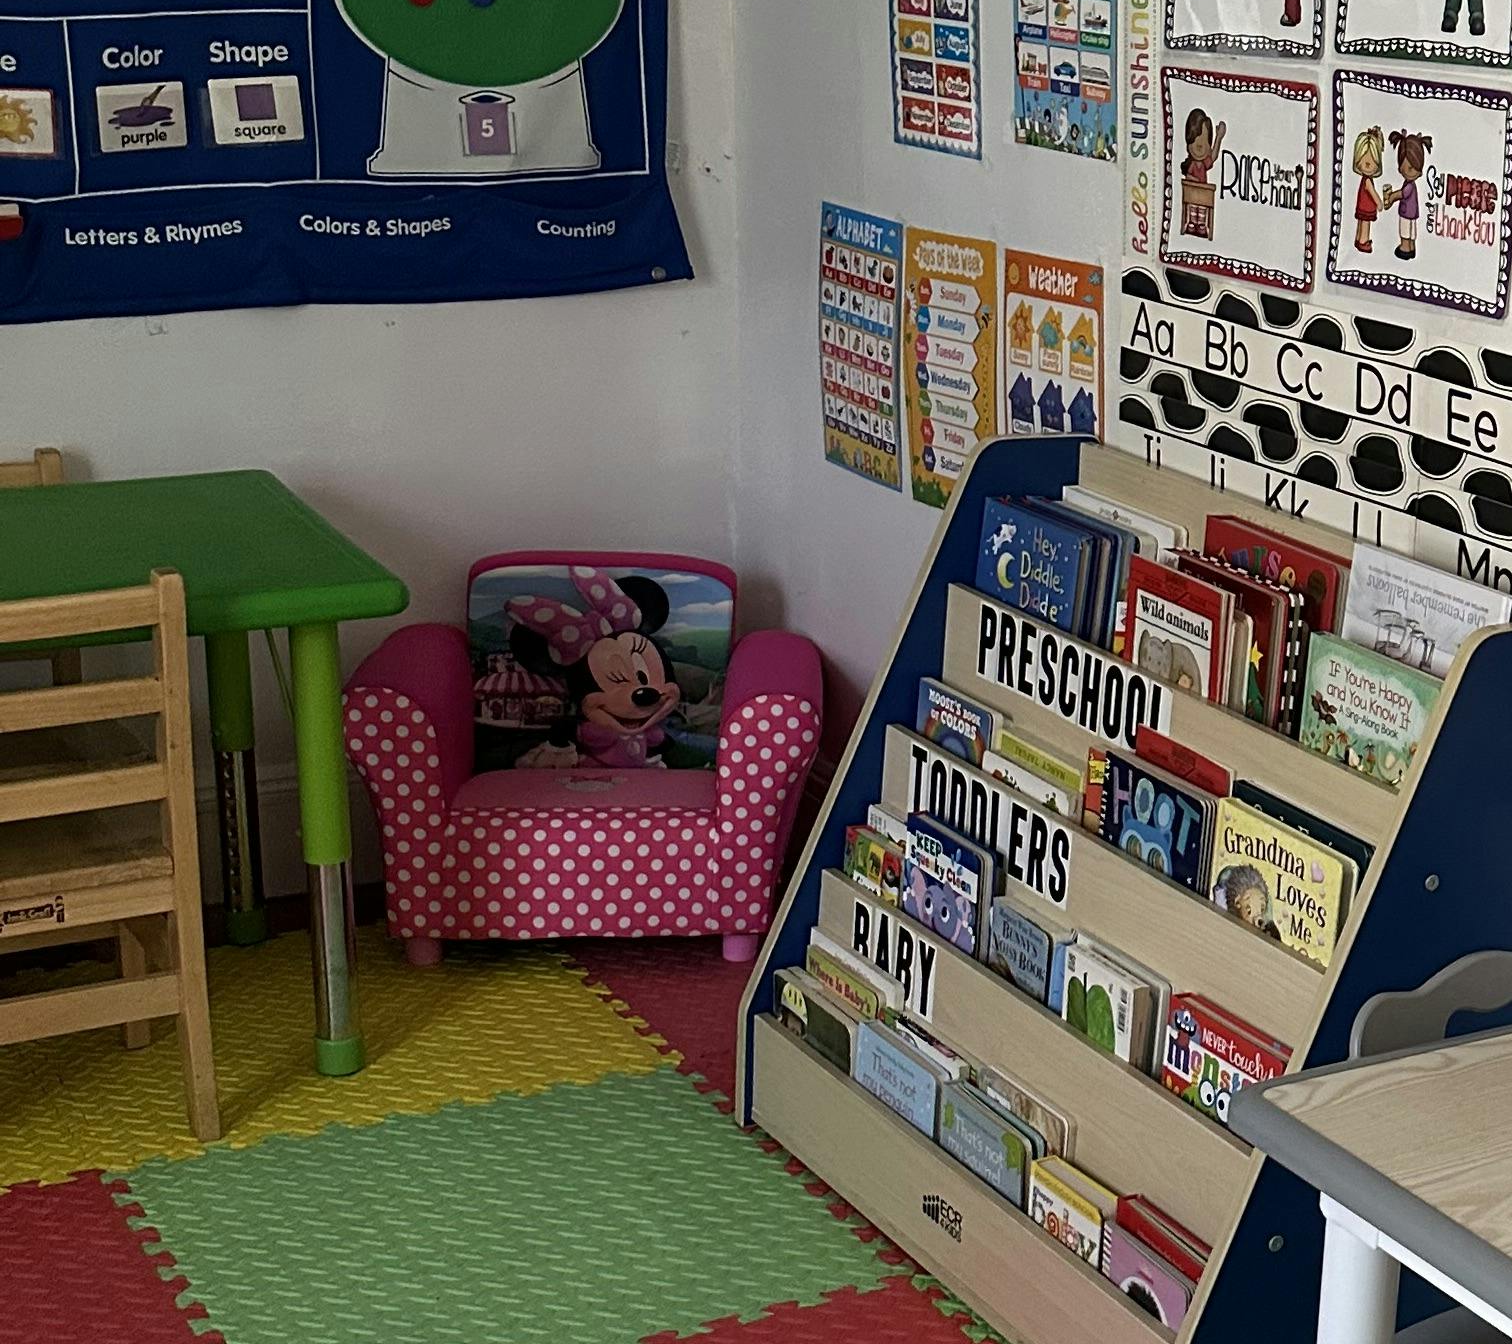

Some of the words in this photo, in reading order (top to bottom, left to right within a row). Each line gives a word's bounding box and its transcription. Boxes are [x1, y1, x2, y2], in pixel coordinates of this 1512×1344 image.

[102, 46, 162, 69] Color
[209, 40, 289, 66] Shape
[120, 128, 168, 148] purple
[234, 123, 287, 140] square
[481, 118, 494, 138] 5
[1220, 150, 1270, 204] Raise
[64, 227, 138, 246] Letters
[144, 227, 160, 243] &
[166, 219, 243, 244] Rhymes
[301, 214, 360, 236] Colors
[366, 220, 380, 236] &
[386, 217, 451, 237] Shapes
[537, 219, 616, 239] Counting
[1446, 391, 1499, 455] Ee
[1140, 595, 1166, 621] Wild
[1166, 610, 1209, 641] animals
[1223, 827, 1305, 881] Grandma
[1275, 873, 1326, 929] Loves
[1290, 914, 1312, 945] Me
